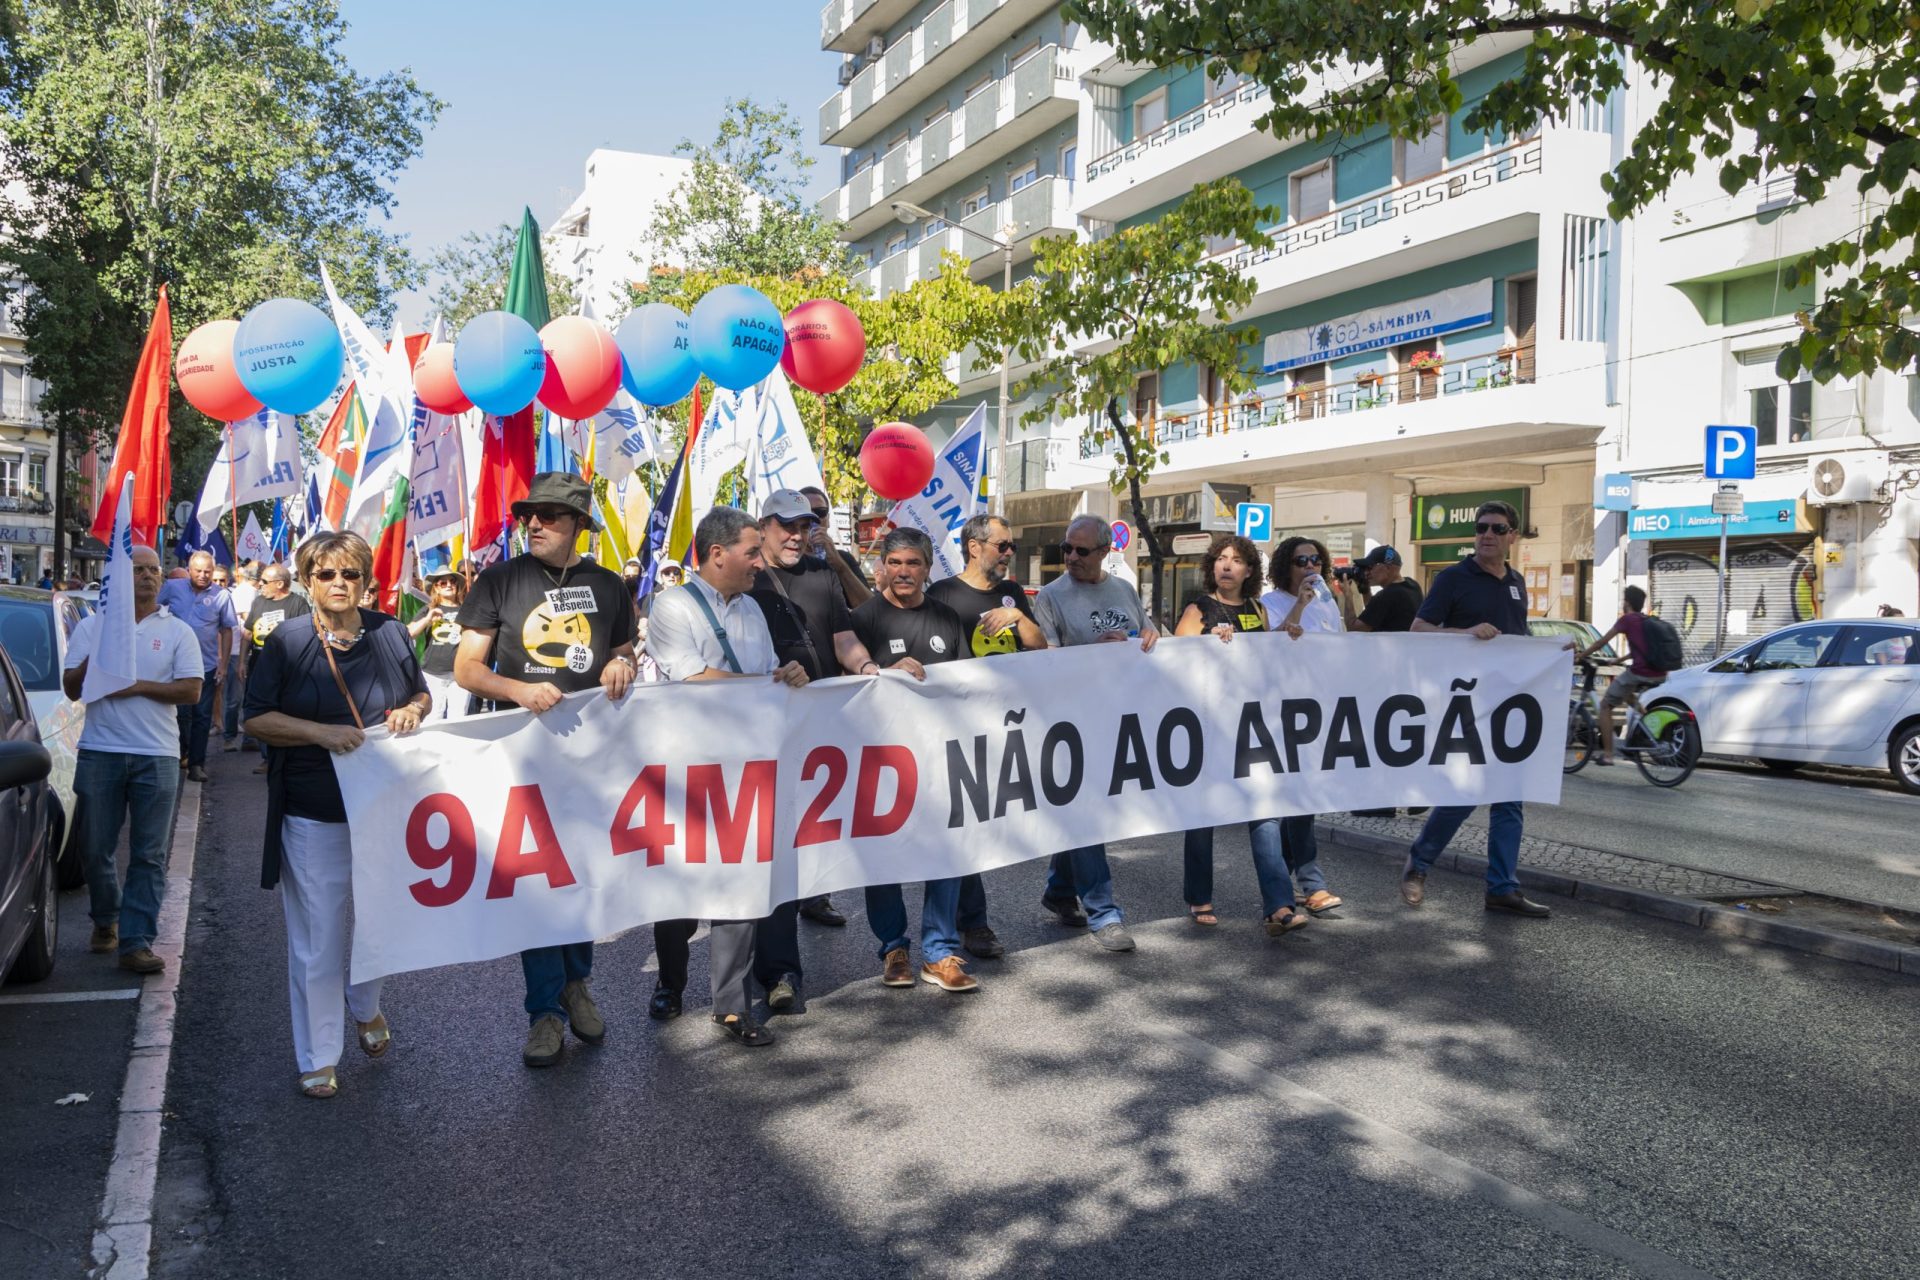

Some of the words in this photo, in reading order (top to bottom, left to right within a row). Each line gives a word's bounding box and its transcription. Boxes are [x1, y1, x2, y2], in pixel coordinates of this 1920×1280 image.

[739, 318, 765, 330] NÃO
[768, 325, 780, 337] AO
[732, 335, 779, 357] APAGÃO
[250, 355, 297, 372] JUSTA
[1715, 430, 1747, 475] P
[1607, 486, 1630, 497] MEO
[1244, 507, 1264, 537] P
[1632, 514, 1670, 532] MEO
[1730, 513, 1750, 524] Reis
[938, 554, 954, 577] Março
[549, 590, 591, 602] Exigimos
[553, 599, 594, 613] Respeito
[572, 654, 587, 662] 4M
[574, 646, 587, 655] 9A
[572, 661, 585, 670] 2D
[405, 784, 577, 907] 9A
[609, 760, 778, 867] 4M
[793, 745, 919, 848] 2D
[946, 707, 1085, 828] NÃO
[1107, 706, 1204, 796] AO
[1233, 677, 1544, 780] APAGÃO
